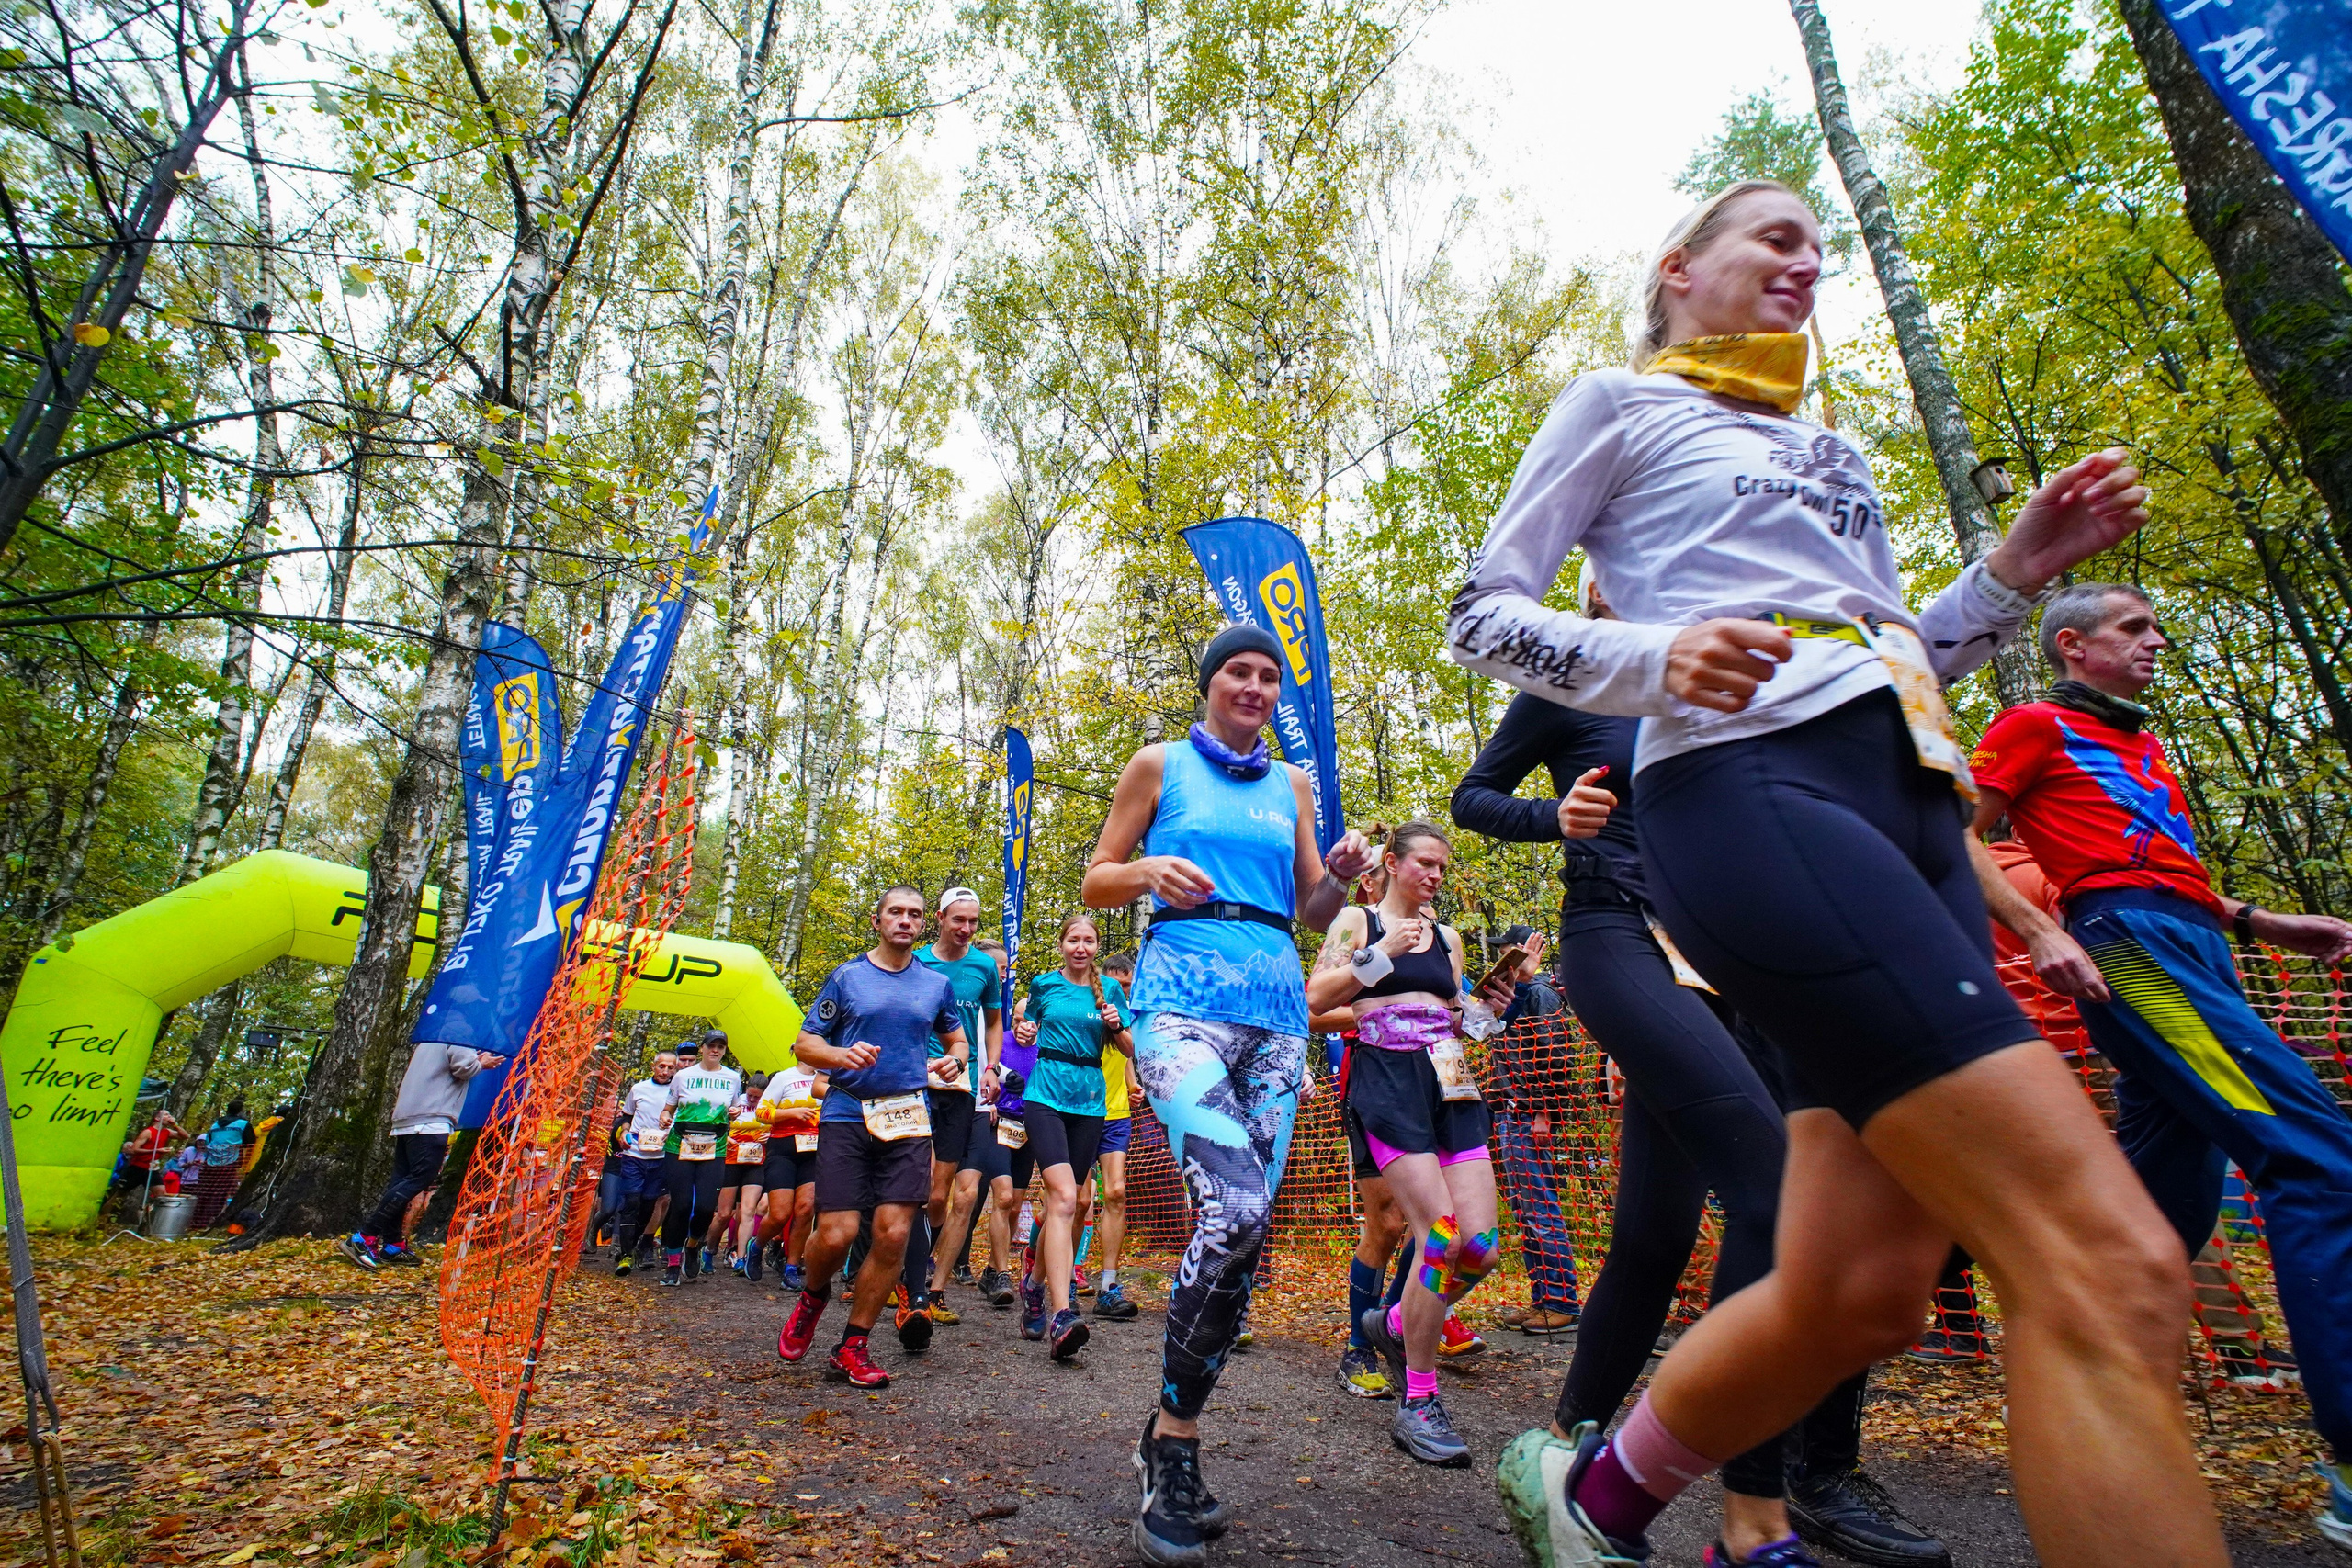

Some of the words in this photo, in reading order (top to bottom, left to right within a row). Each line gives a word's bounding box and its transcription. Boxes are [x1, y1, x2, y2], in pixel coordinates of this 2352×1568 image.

[1734, 474, 1797, 499] Crazy
[47, 1024, 128, 1055] Feel
[20, 1058, 123, 1092] there's
[686, 1077, 731, 1090] IZMYLONG
[49, 1093, 122, 1127] limit
[884, 1109, 912, 1122] 148
[1007, 1130, 1024, 1138] 106
